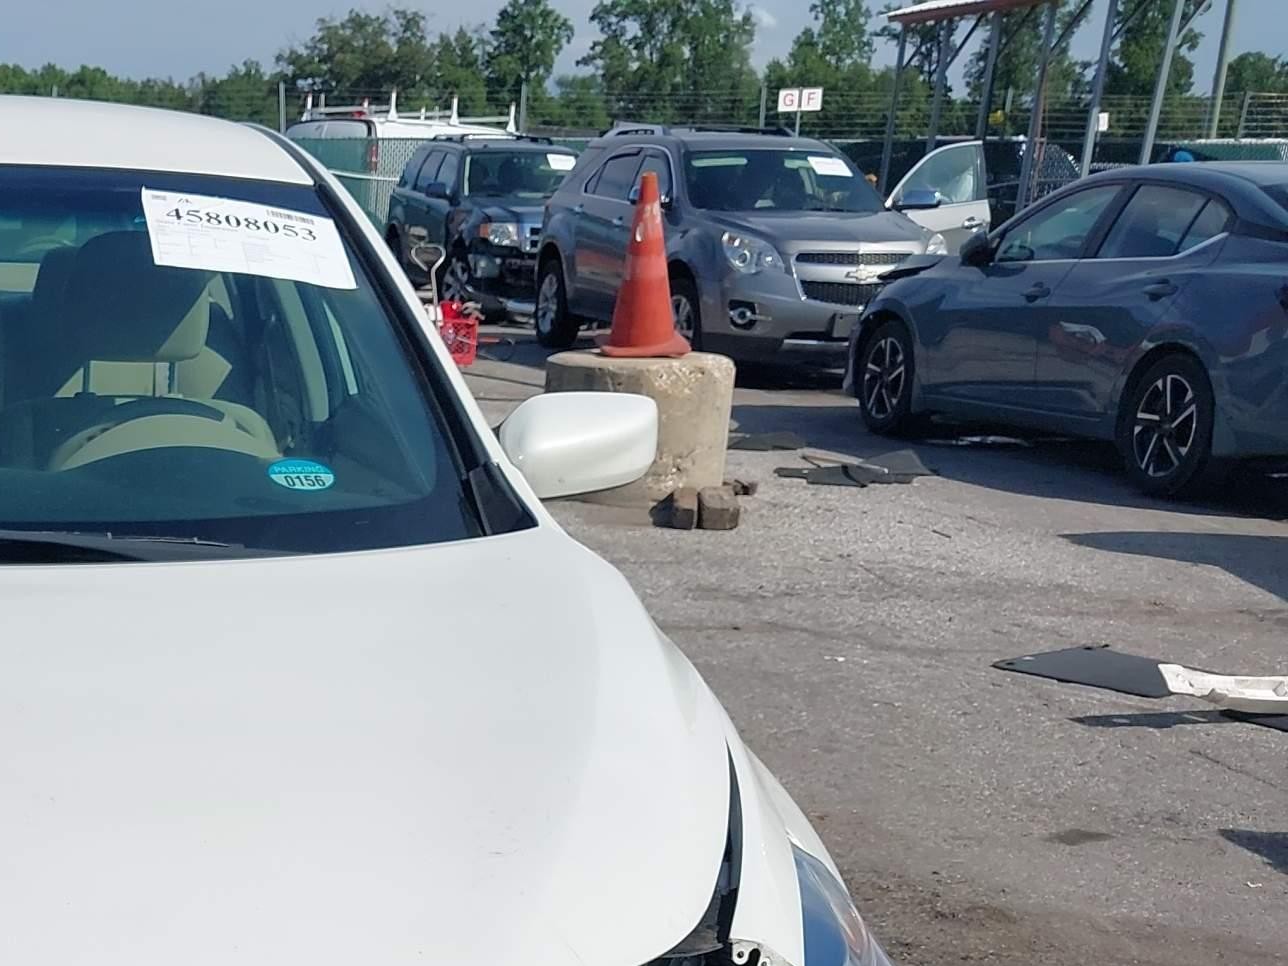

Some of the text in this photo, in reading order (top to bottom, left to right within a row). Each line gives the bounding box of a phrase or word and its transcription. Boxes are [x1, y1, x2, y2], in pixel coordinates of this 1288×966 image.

[783, 92, 816, 106] G F
[165, 207, 318, 242] 45808053
[284, 475, 326, 487] 0156
